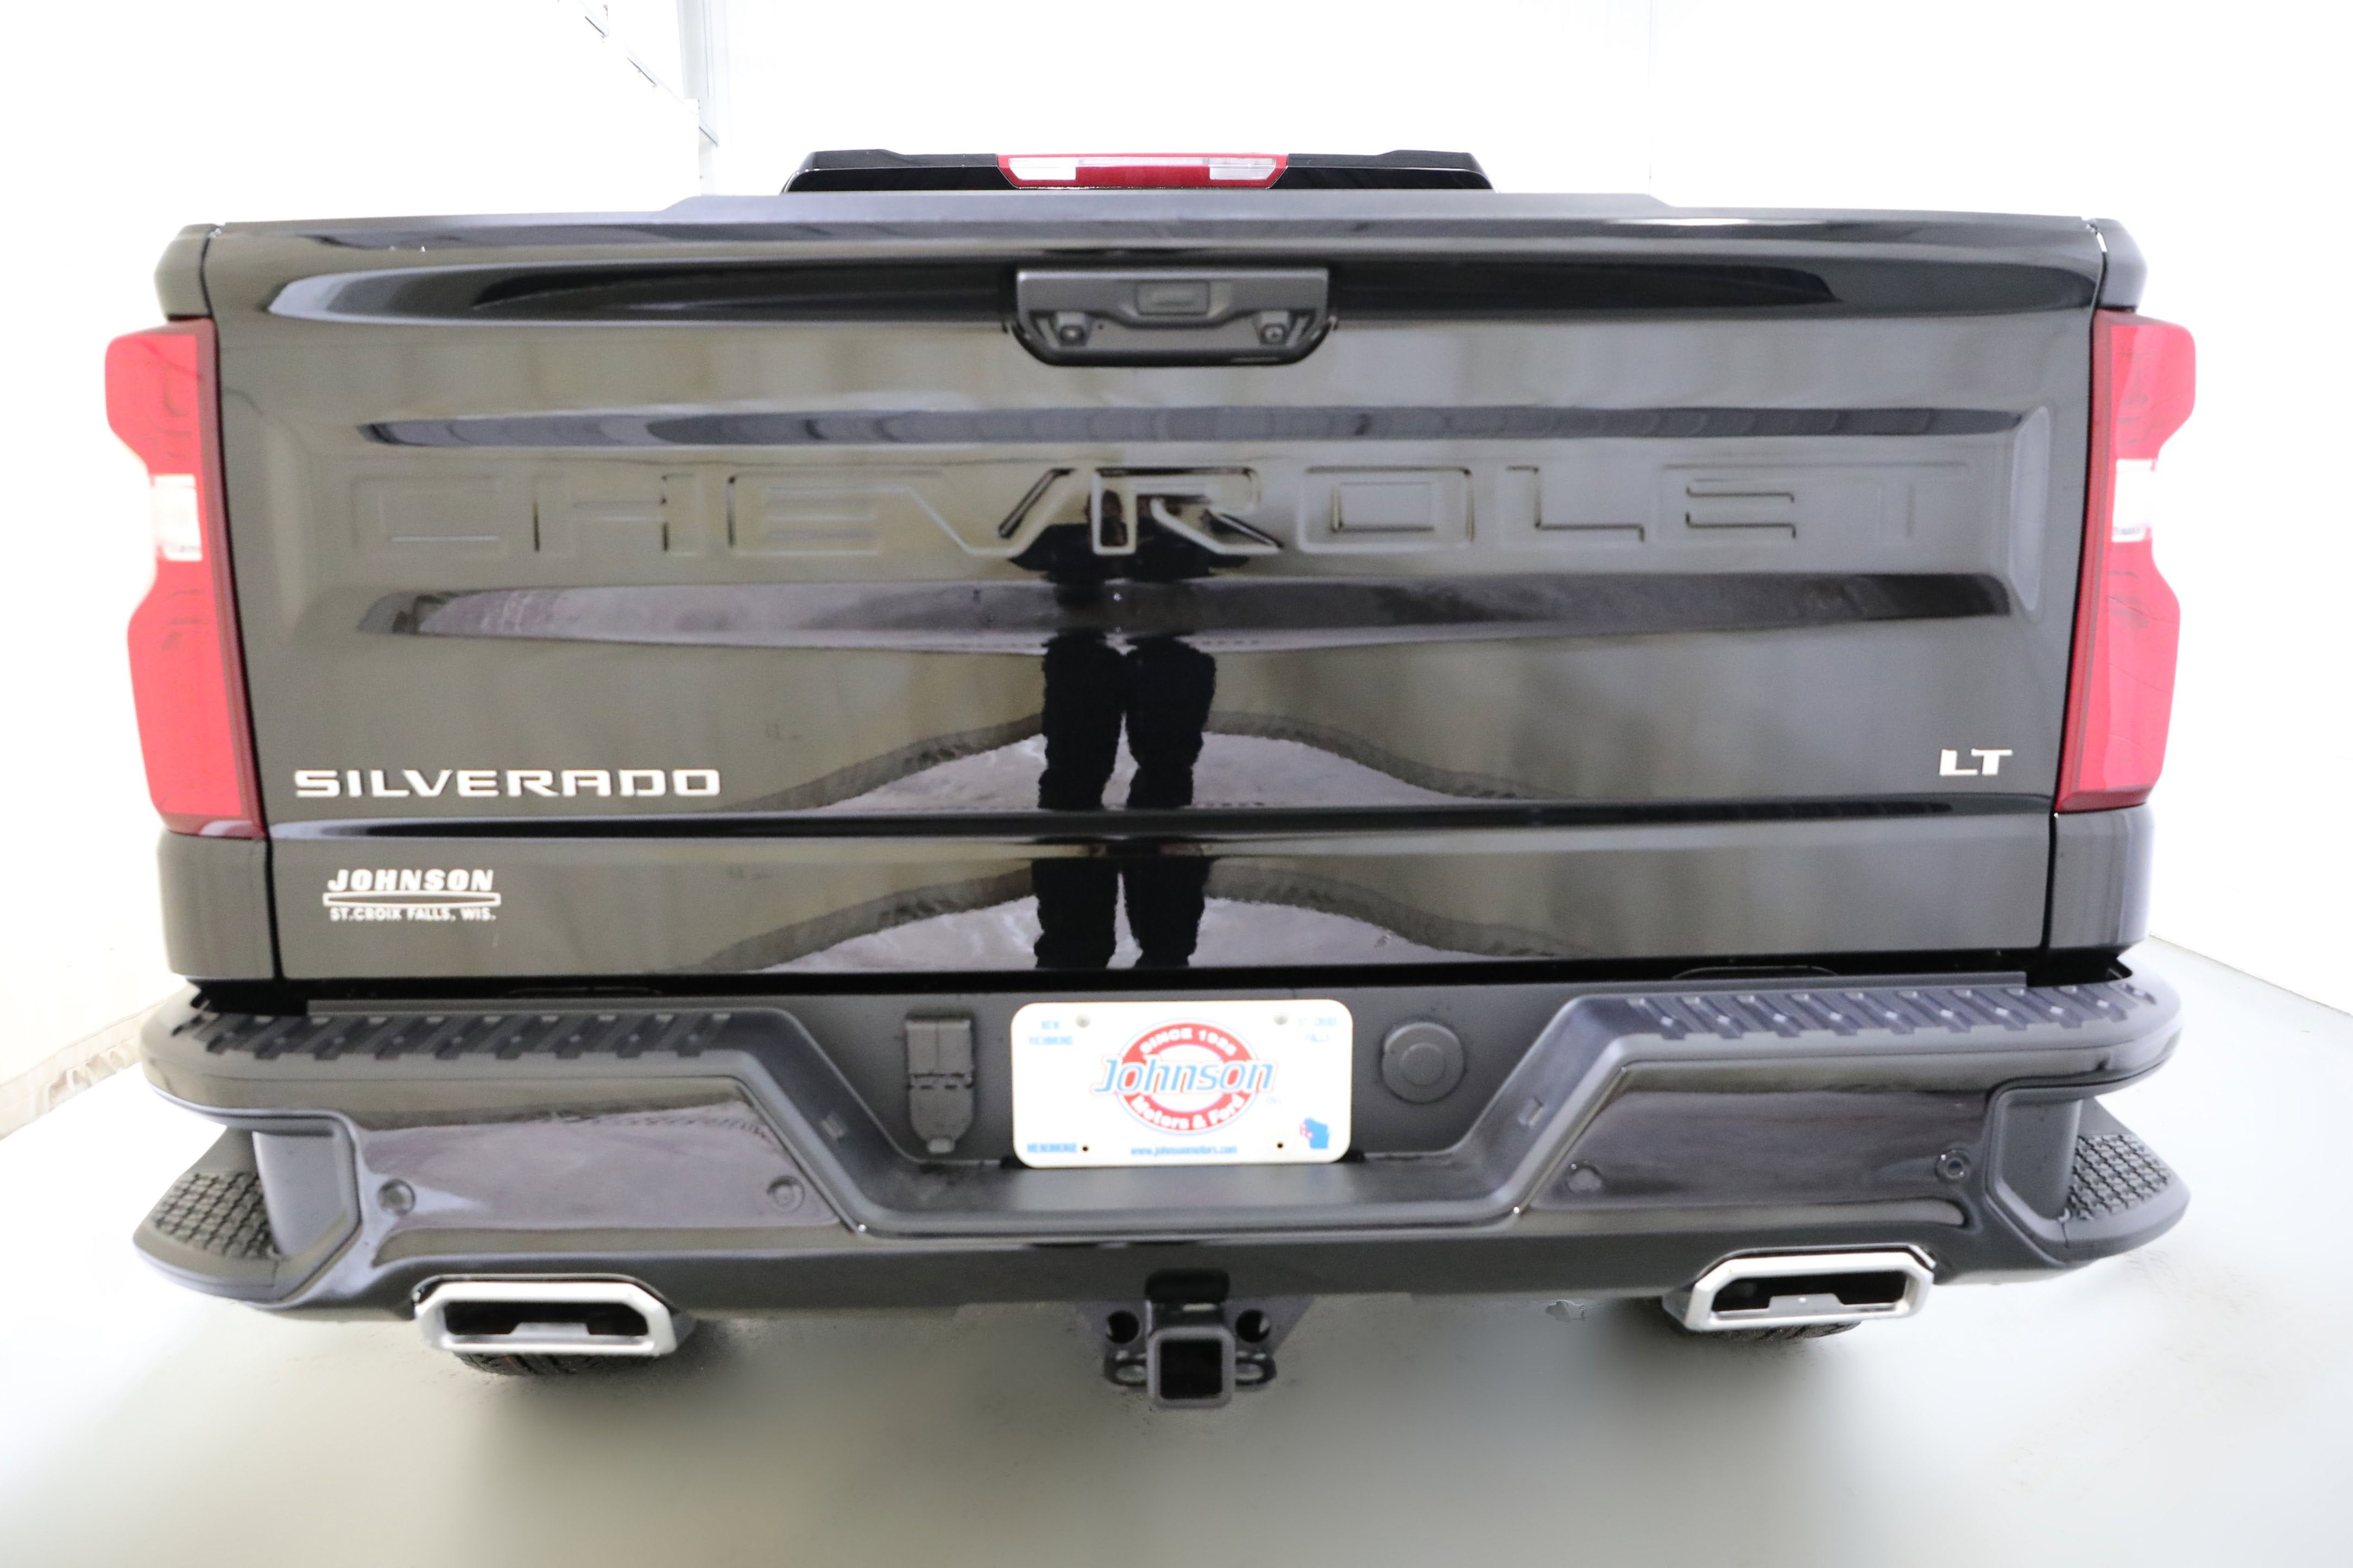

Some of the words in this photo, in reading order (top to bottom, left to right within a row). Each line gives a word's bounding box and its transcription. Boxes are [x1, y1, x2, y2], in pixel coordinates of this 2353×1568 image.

[349, 460, 1970, 557] CHEVROLET
[1939, 748, 2013, 776] LT
[294, 768, 721, 798] SILVERADO
[327, 869, 494, 891] JOHNSON
[460, 907, 497, 921] WIS.
[1139, 1027, 1194, 1054] SINCE
[1093, 1057, 1275, 1093] Johnson
[1130, 1093, 1190, 1130] Motors
[1192, 1114, 1208, 1129] &
[1207, 1092, 1246, 1127] Ford
